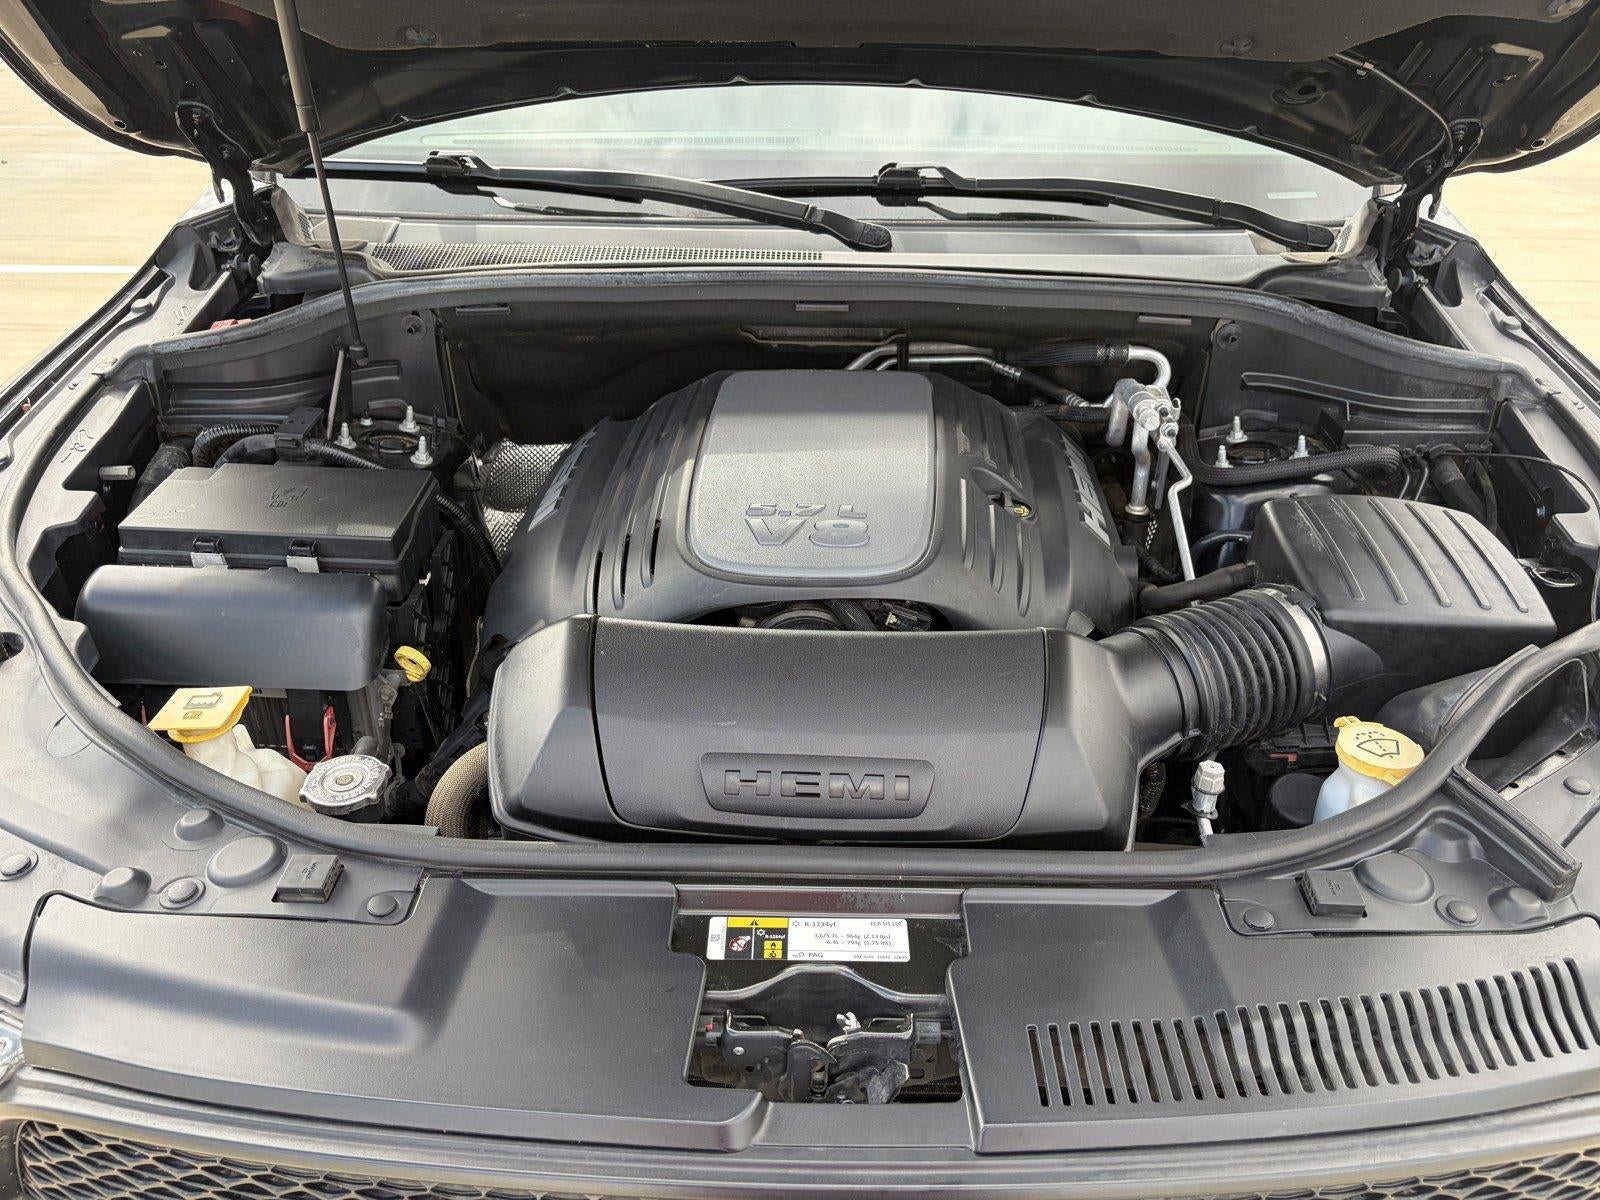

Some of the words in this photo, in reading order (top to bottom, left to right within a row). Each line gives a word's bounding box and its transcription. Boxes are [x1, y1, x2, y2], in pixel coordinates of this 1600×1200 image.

[1062, 434, 1111, 547] HEMI
[744, 517, 871, 548] V8
[723, 769, 911, 801] HEMI
